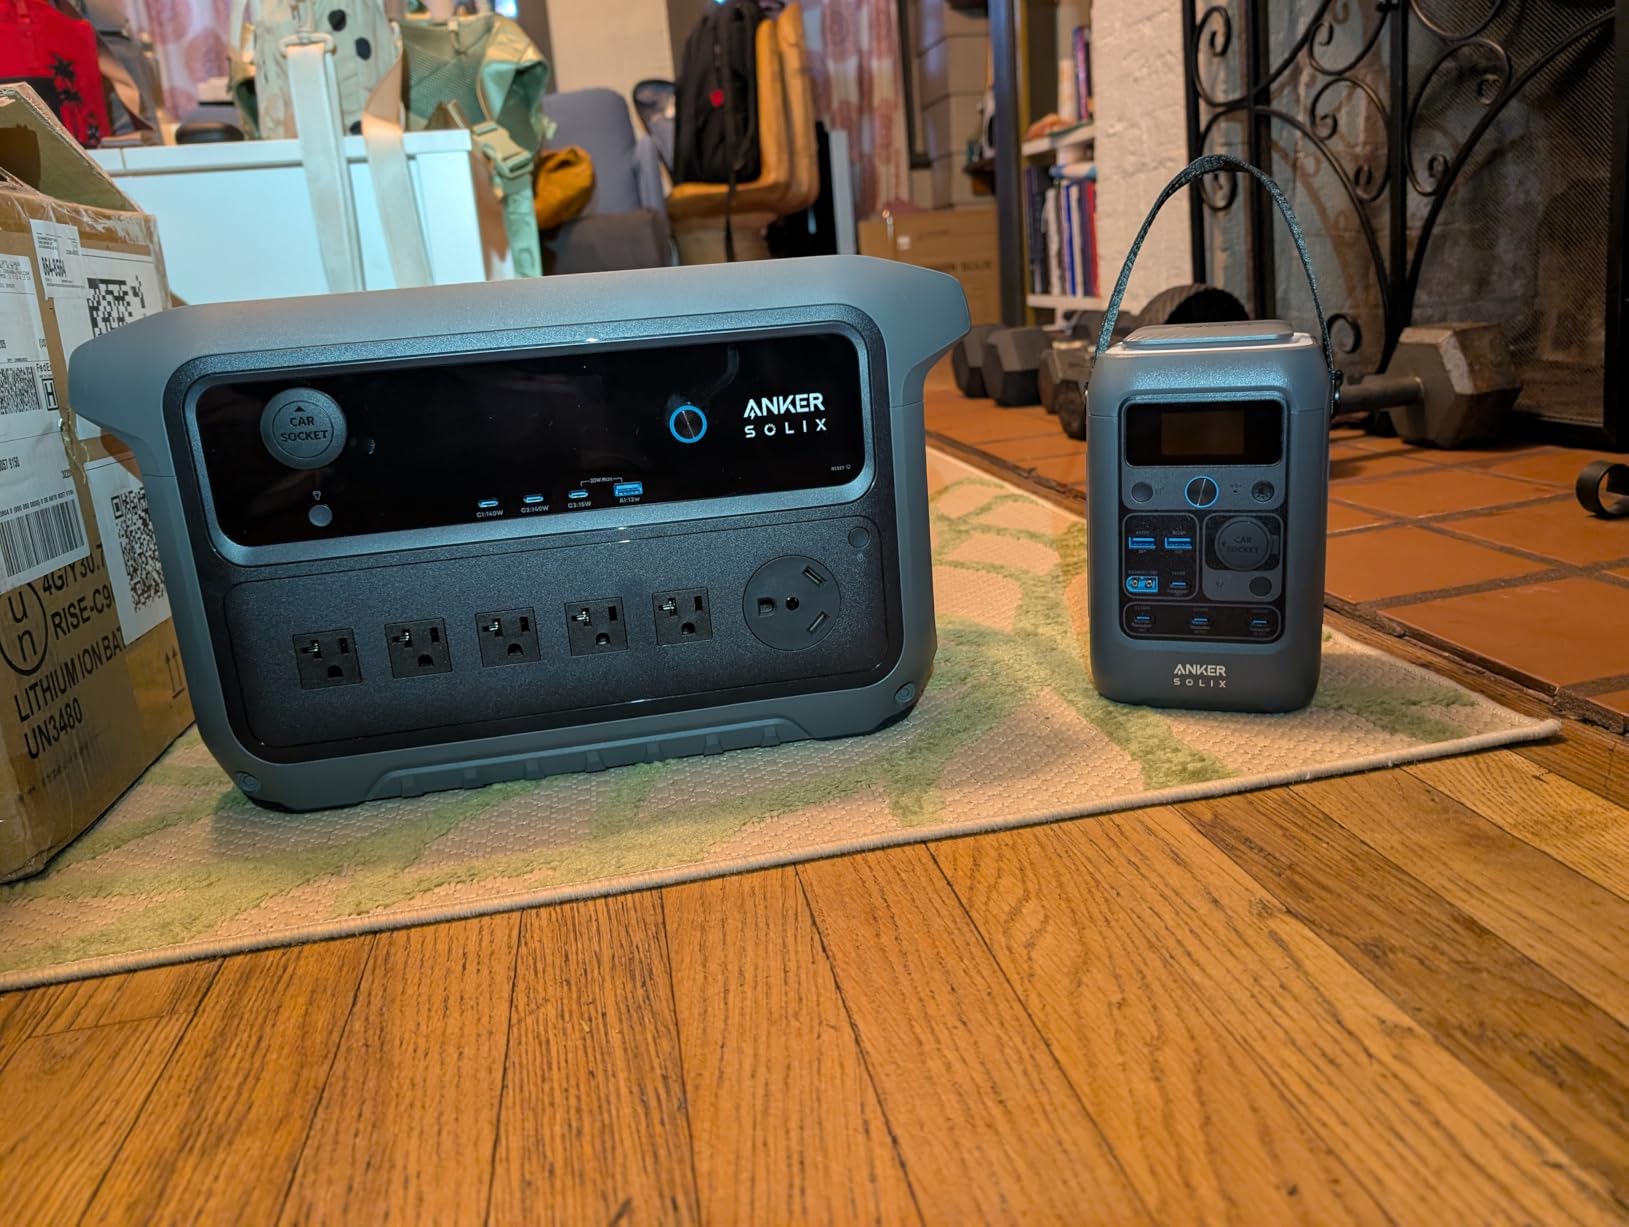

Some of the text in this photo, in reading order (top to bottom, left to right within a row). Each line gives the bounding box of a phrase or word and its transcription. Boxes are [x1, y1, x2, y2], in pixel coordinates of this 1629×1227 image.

[743, 393, 826, 420] ANKER
[289, 416, 315, 427] CAR
[744, 418, 828, 438] SOLIX
[280, 430, 329, 442] SOCKET
[476, 509, 504, 518] C1:140W
[1173, 664, 1226, 677] ANKER
[14, 656, 79, 722] LITHIUM
[77, 640, 103, 679] ION
[1173, 678, 1227, 688] SOLIX
[24, 697, 82, 760] UN3480
